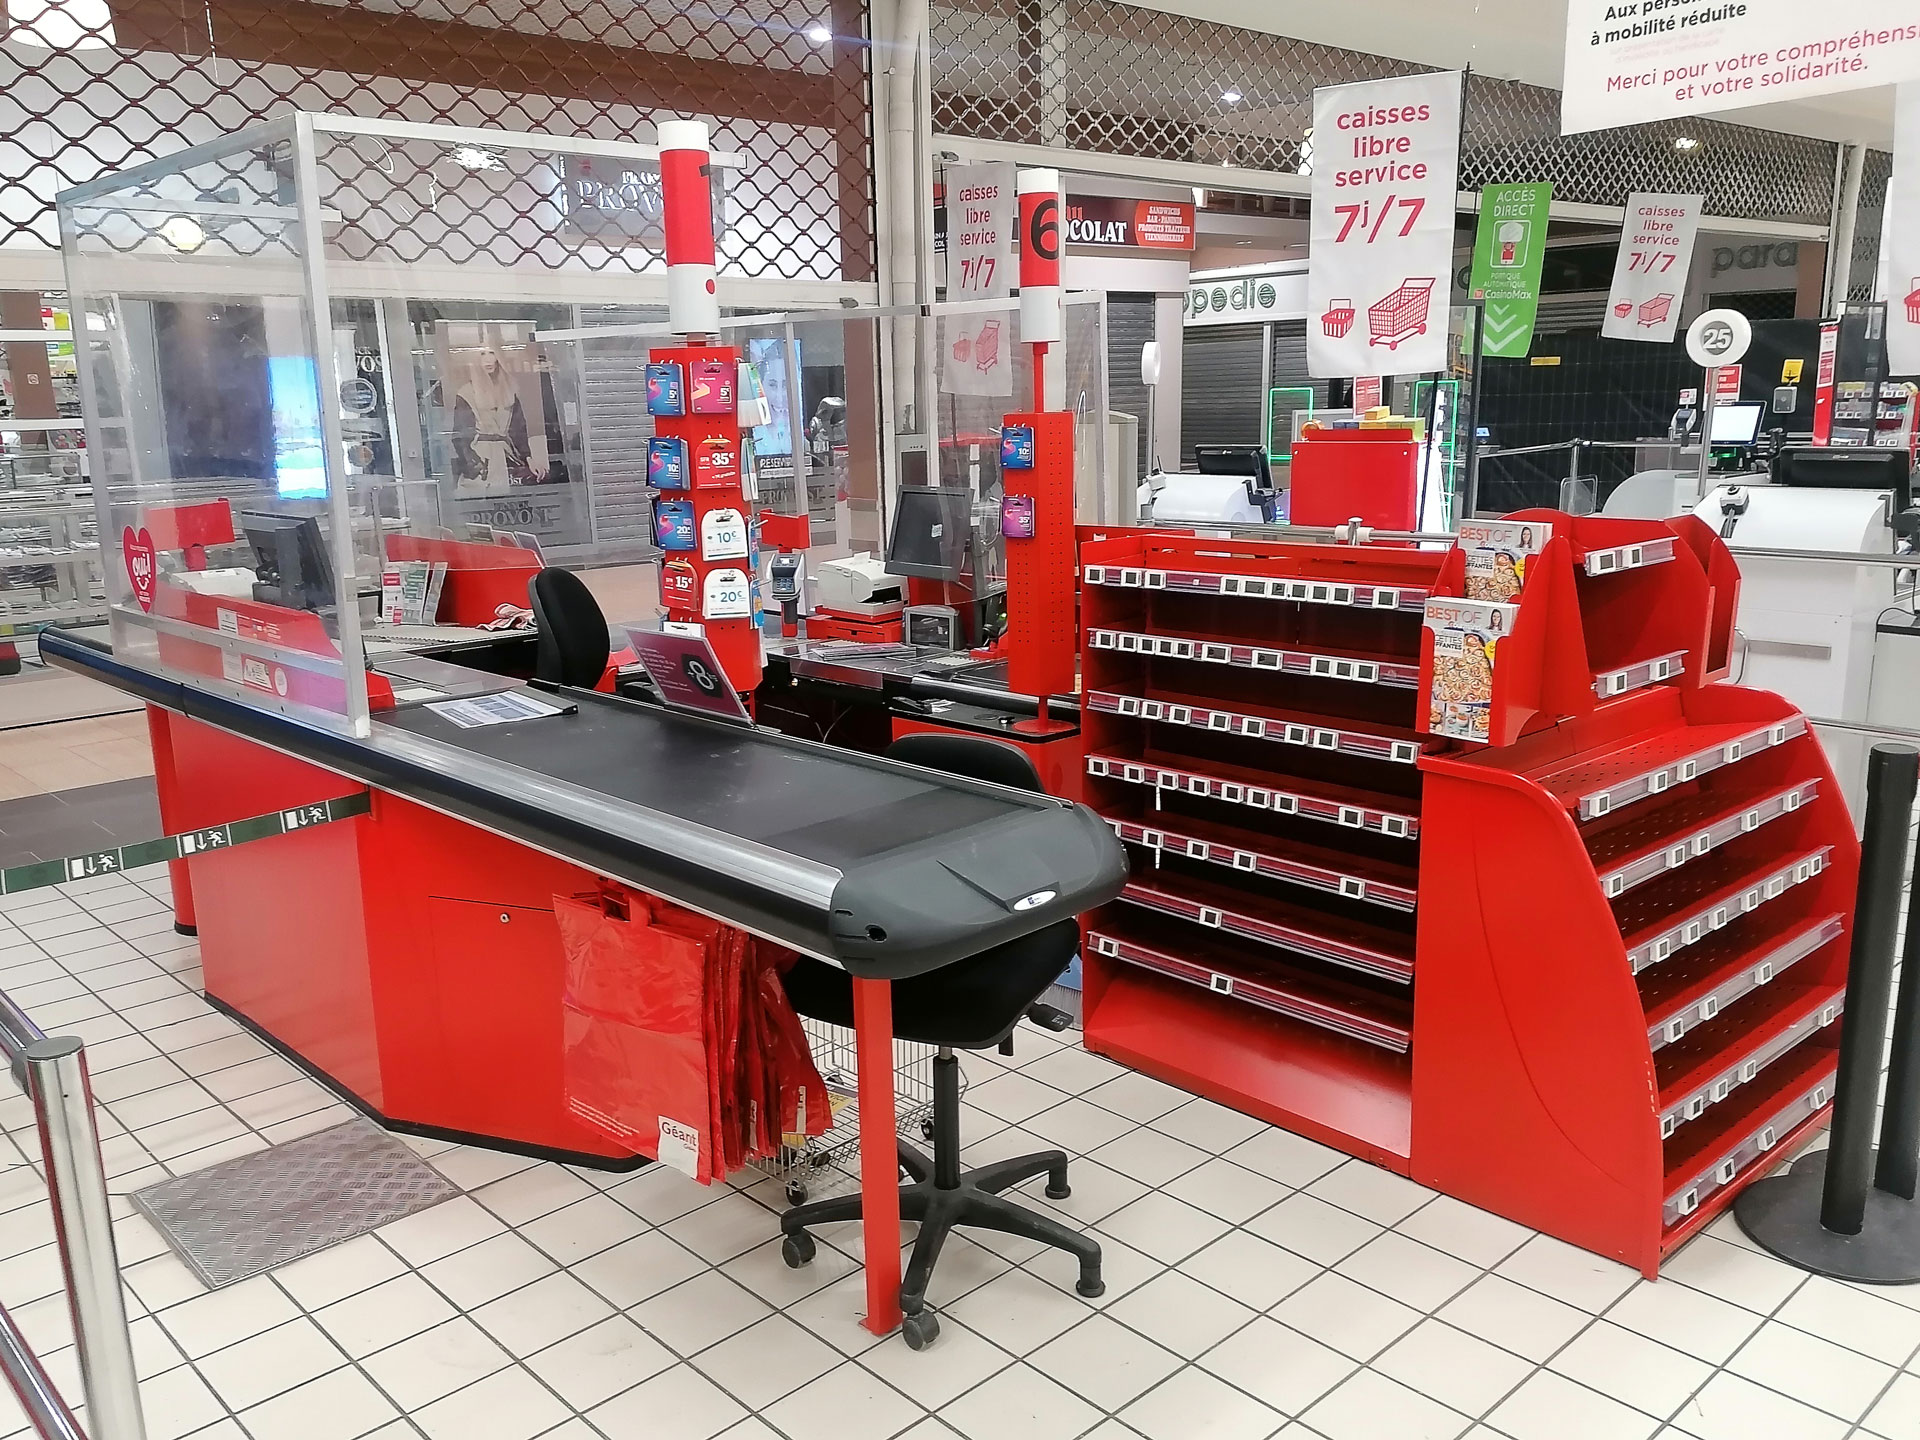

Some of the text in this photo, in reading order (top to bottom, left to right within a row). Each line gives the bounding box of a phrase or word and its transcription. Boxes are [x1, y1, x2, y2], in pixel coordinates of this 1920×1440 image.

[1604, 3, 1638, 21] Aux
[1590, 30, 1600, 46] à
[1604, 15, 1676, 43] mobilité
[1681, 3, 1747, 28] réduite
[1606, 23, 1920, 93] Merci pour votre compréhens
[1675, 53, 1868, 101] et votre solidarité.
[1336, 104, 1430, 130] caisses
[1353, 135, 1411, 158] libre
[1335, 160, 1428, 187] service
[576, 180, 663, 213] PROV
[959, 183, 999, 202] caisses
[1496, 186, 1536, 203] ACCÈS
[966, 207, 991, 224] libre
[1493, 204, 1536, 217] DIRECT
[1638, 205, 1685, 217] caisses
[1643, 219, 1674, 232] libre
[960, 227, 996, 246] service
[1632, 233, 1680, 246] service
[1710, 241, 1800, 279] para
[1703, 327, 1733, 349] 25
[711, 452, 735, 466] 35€
[1460, 526, 1513, 543] BEST OF
[1426, 606, 1483, 624] BEST OF
[661, 1121, 697, 1147] Géant
